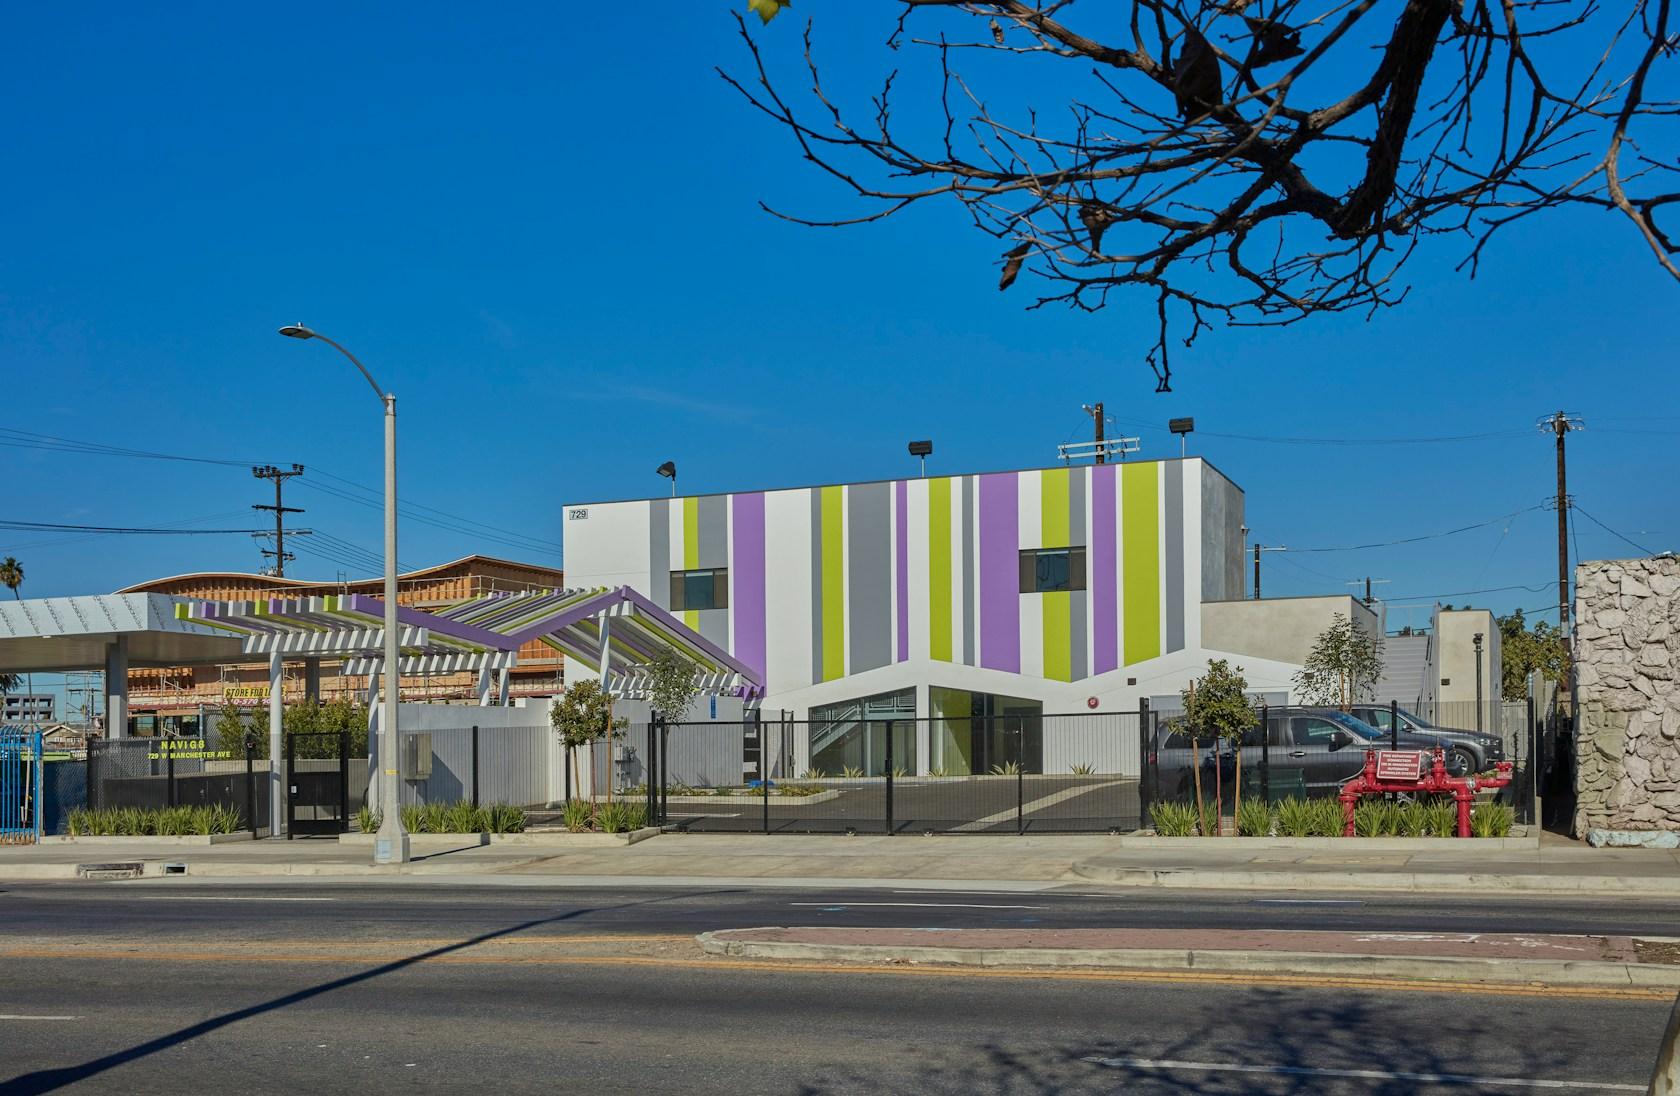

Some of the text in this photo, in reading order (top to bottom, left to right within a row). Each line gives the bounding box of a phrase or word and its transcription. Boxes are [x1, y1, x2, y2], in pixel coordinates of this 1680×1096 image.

[571, 510, 586, 519] 729
[225, 688, 249, 697] STORE
[250, 688, 264, 697] FOR
[161, 739, 205, 750] NAVIG8
[170, 751, 215, 759] MANCHESTER
